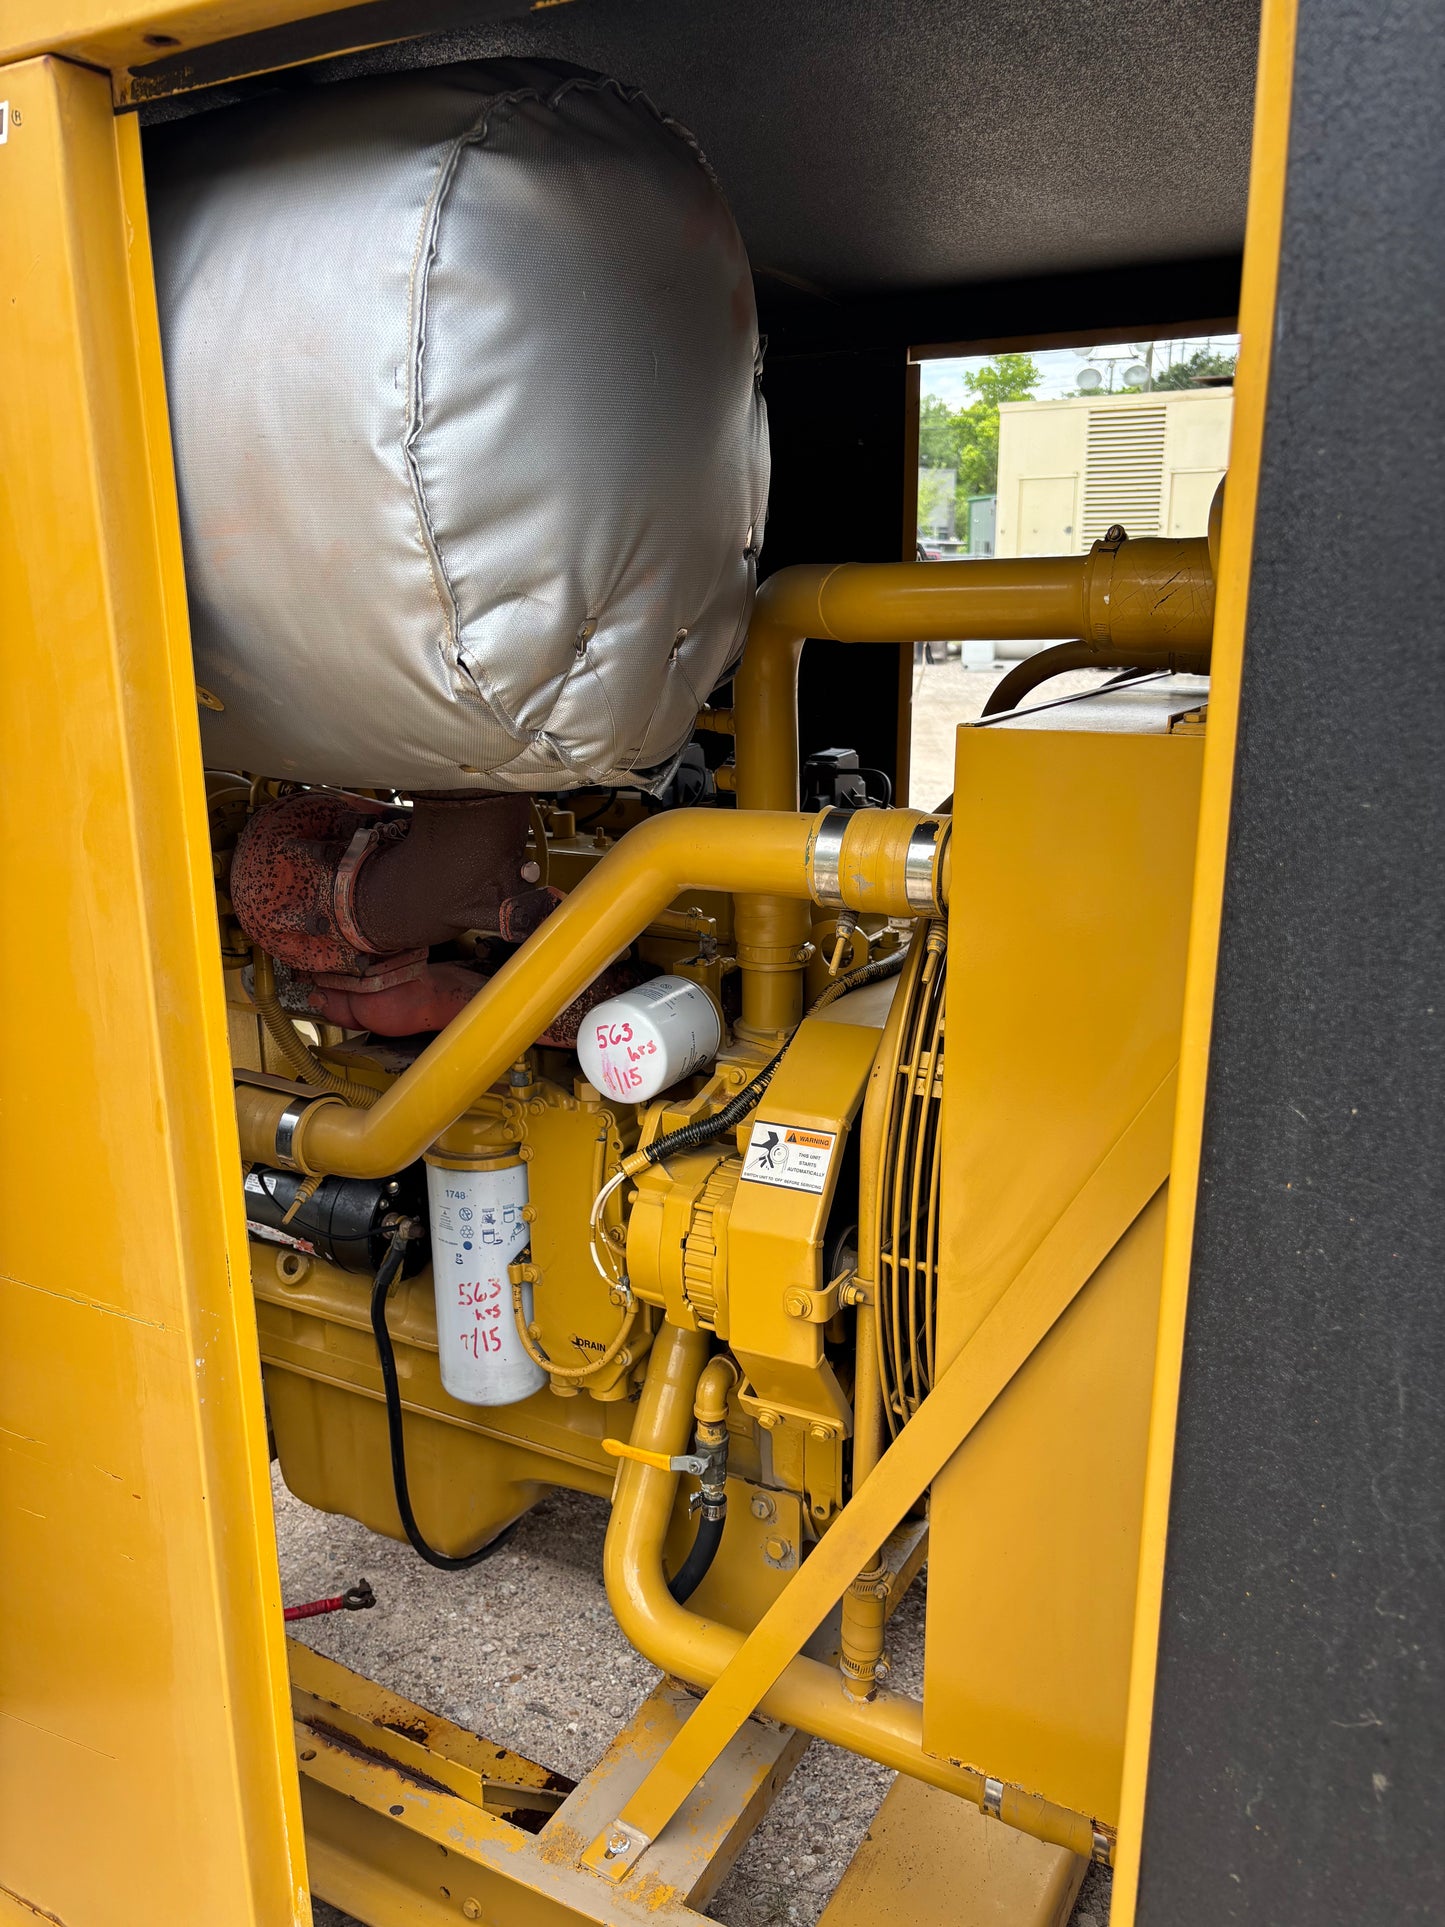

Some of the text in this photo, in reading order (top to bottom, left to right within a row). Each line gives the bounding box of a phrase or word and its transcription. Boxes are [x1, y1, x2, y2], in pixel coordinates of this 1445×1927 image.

[597, 1023, 633, 1049] 563
[627, 1040, 657, 1062] hrs
[799, 1135, 830, 1146] WARNING
[787, 1167, 825, 1177] AUTOMATICALLY
[784, 1179, 800, 1187] BEFORE
[800, 1182, 822, 1190] SERVICING
[445, 1190, 466, 1200] 1748
[458, 1278, 501, 1306] 563
[475, 1303, 501, 1321] hrs
[460, 1326, 502, 1359] 7/15
[577, 1338, 606, 1352] DRAIN
